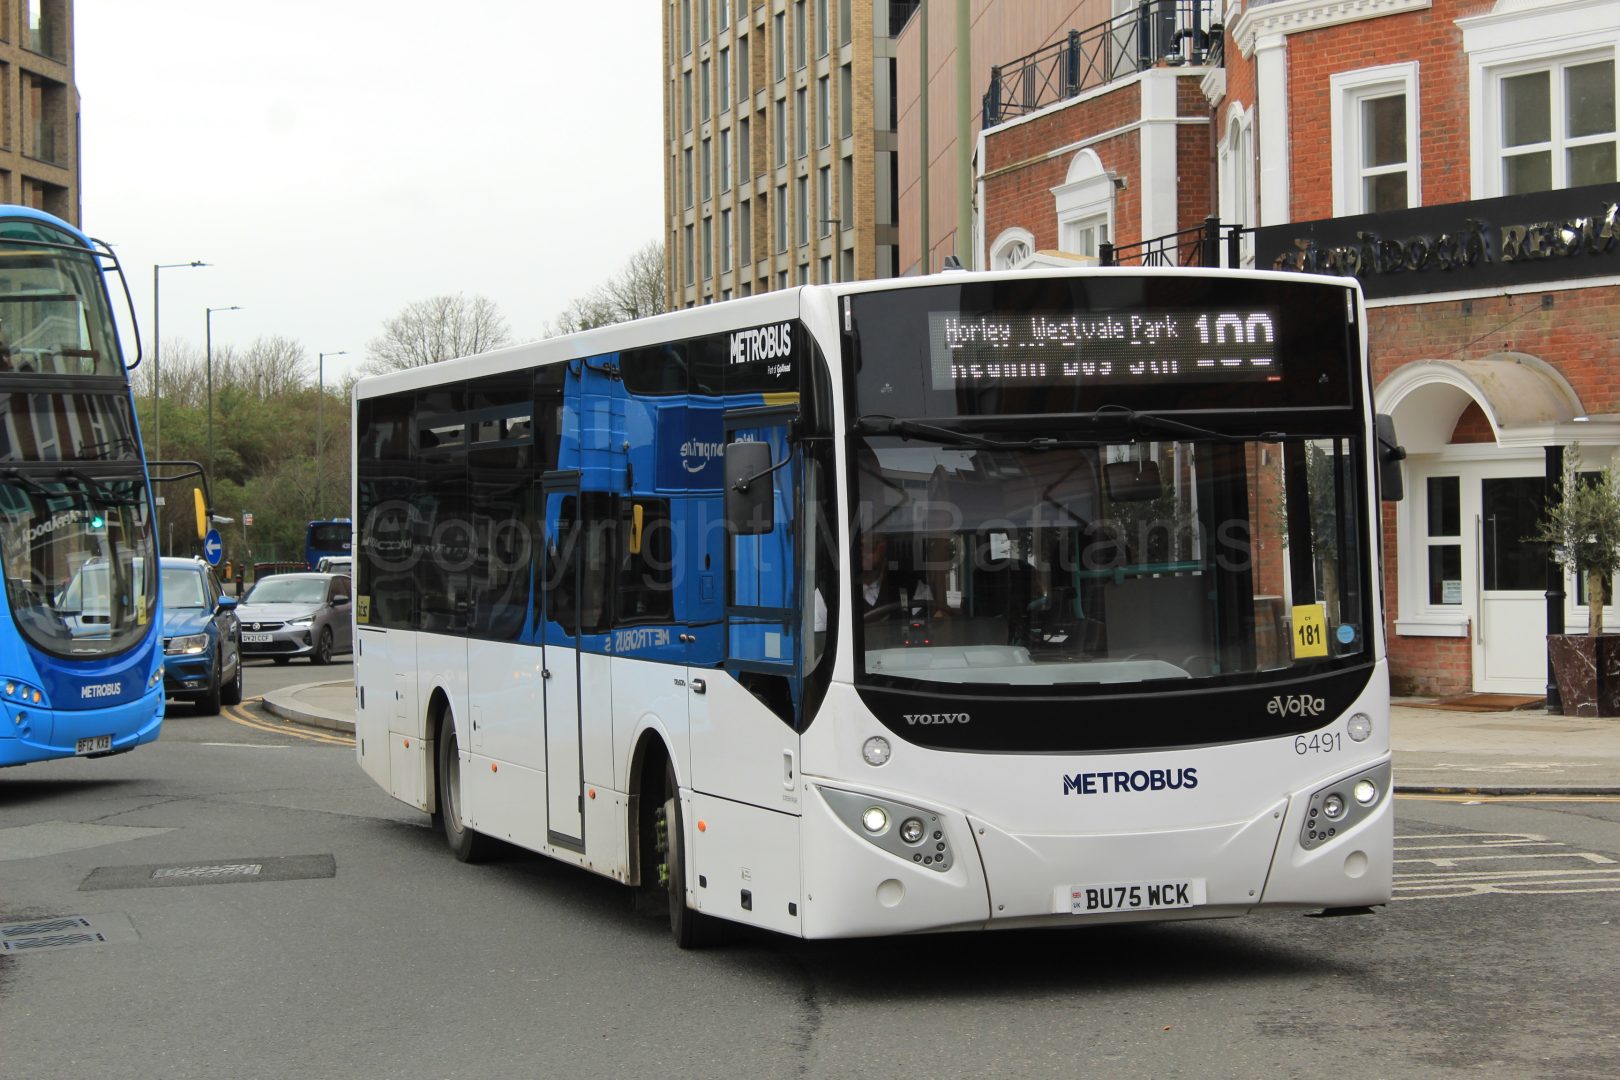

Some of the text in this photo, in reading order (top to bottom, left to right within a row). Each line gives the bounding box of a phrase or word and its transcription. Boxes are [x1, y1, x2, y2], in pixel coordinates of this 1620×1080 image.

[945, 314, 1179, 342] Horley Westvale Park
[730, 322, 791, 365] METROBUS
[1298, 623, 1321, 646] 181
[81, 682, 121, 699] METROBUS
[903, 712, 970, 726] VOLVO
[1294, 731, 1341, 755] 6491
[1063, 767, 1198, 796] METROBUS
[1086, 883, 1190, 910] BU75 WCK
